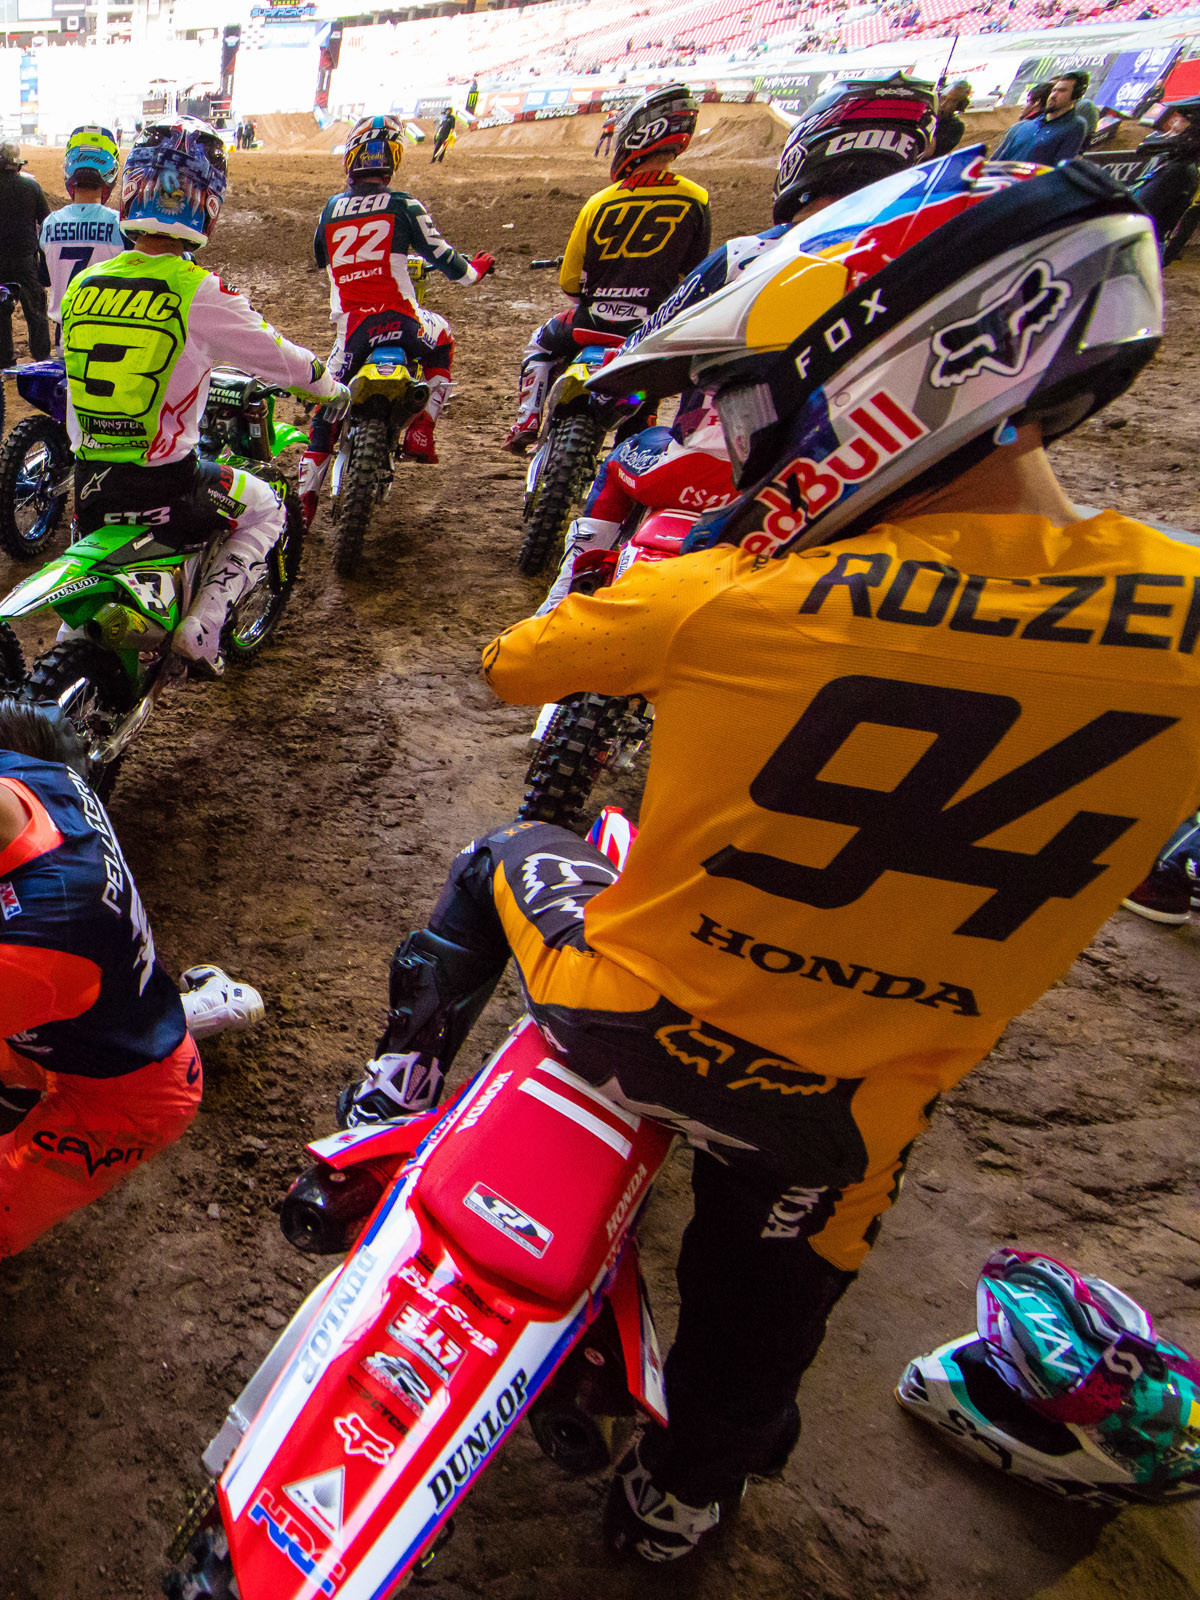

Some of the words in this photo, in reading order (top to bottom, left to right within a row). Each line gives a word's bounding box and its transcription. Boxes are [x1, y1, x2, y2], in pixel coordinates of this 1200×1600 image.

[763, 75, 812, 89] MONSTER
[1053, 53, 1110, 69] MONSTER
[825, 129, 916, 159] COLE
[331, 193, 392, 218] REED
[332, 219, 391, 268] 22
[594, 200, 692, 261] 46
[58, 246, 95, 292] 7
[338, 267, 383, 284] SUZUKI
[64, 286, 182, 322] TOMAC
[593, 287, 650, 298] SUZUKI
[367, 321, 401, 337] TWO
[368, 330, 403, 347] TWO
[795, 288, 889, 379] FOX
[68, 320, 179, 419] 3
[784, 391, 931, 518] Bull
[46, 575, 100, 603] DUNLOP
[699, 673, 1180, 942] 94
[689, 912, 983, 1018] HONDA
[455, 1070, 515, 1132] HONDA
[604, 1163, 649, 1240] HONDA
[427, 1367, 531, 1514] DUNLOP
